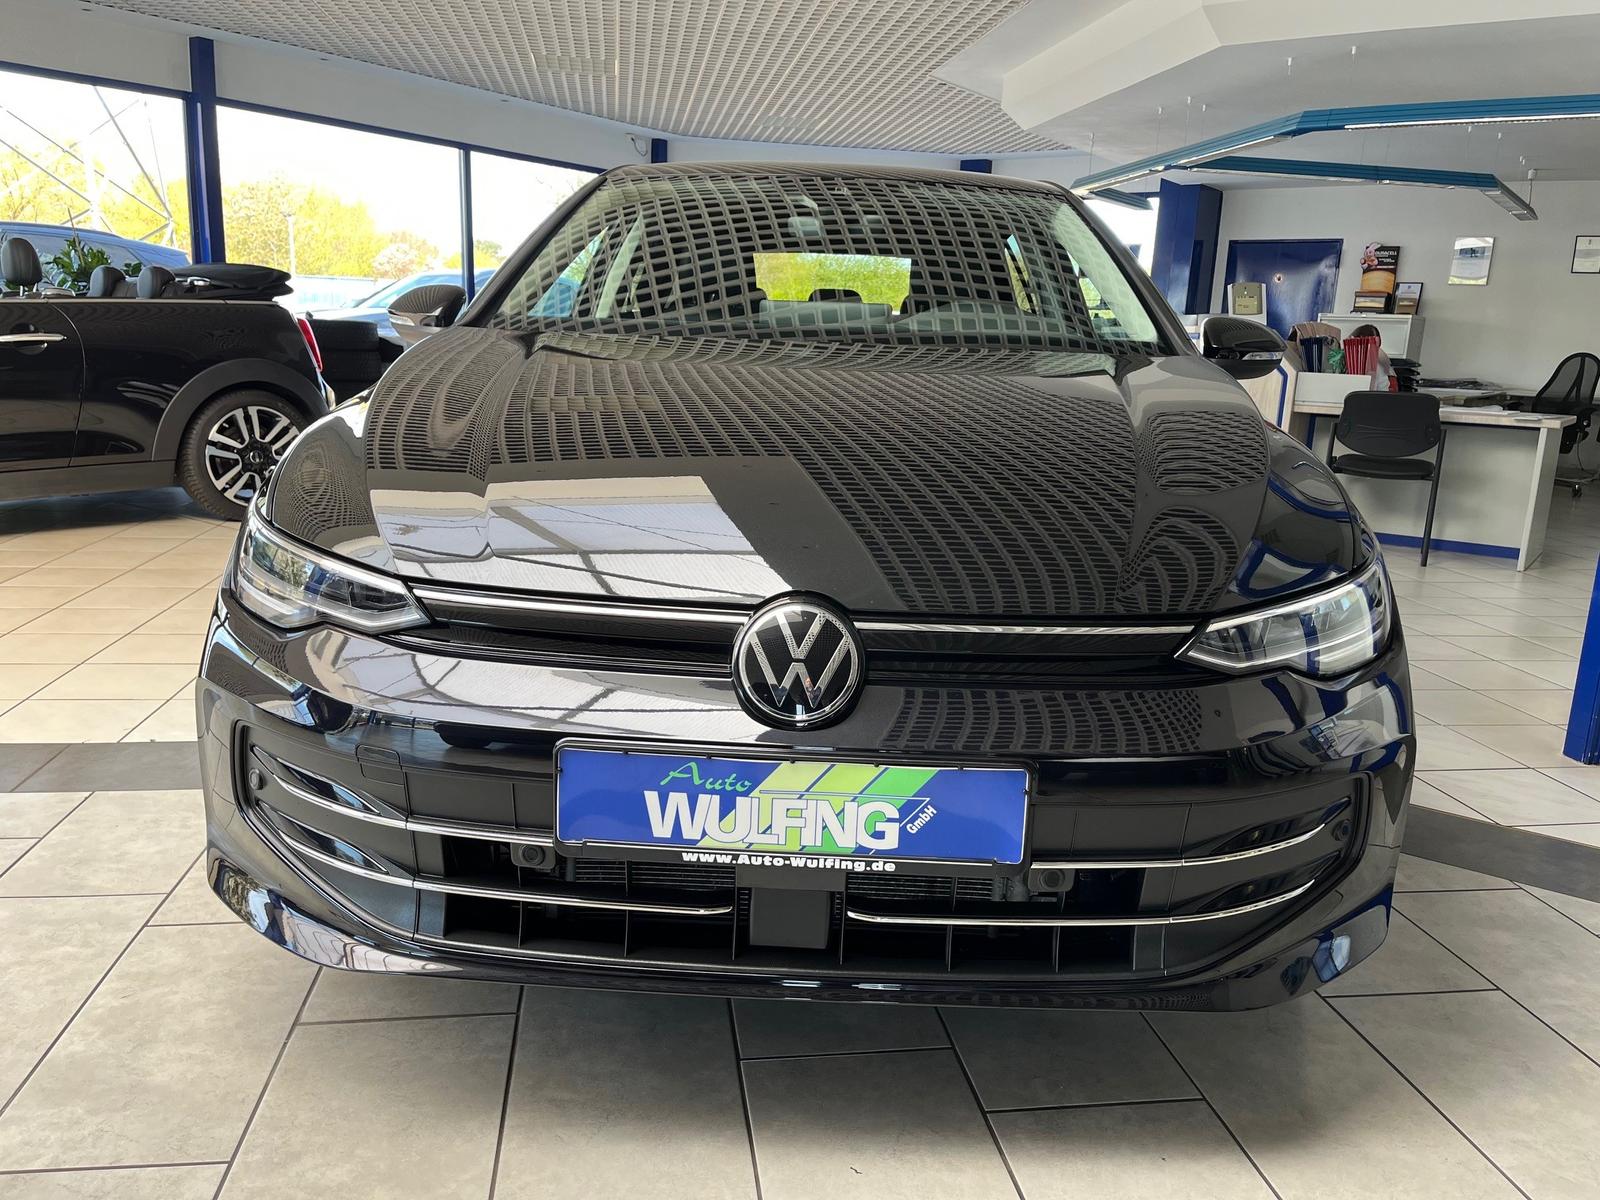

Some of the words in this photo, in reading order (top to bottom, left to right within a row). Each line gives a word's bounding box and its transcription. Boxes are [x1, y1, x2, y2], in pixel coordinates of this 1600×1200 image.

[743, 607, 856, 715] VW
[660, 761, 752, 792] Auto
[643, 790, 900, 850] WULFING
[906, 805, 937, 834] GmbH
[681, 852, 896, 872] www.Auto-Wulfing.de
